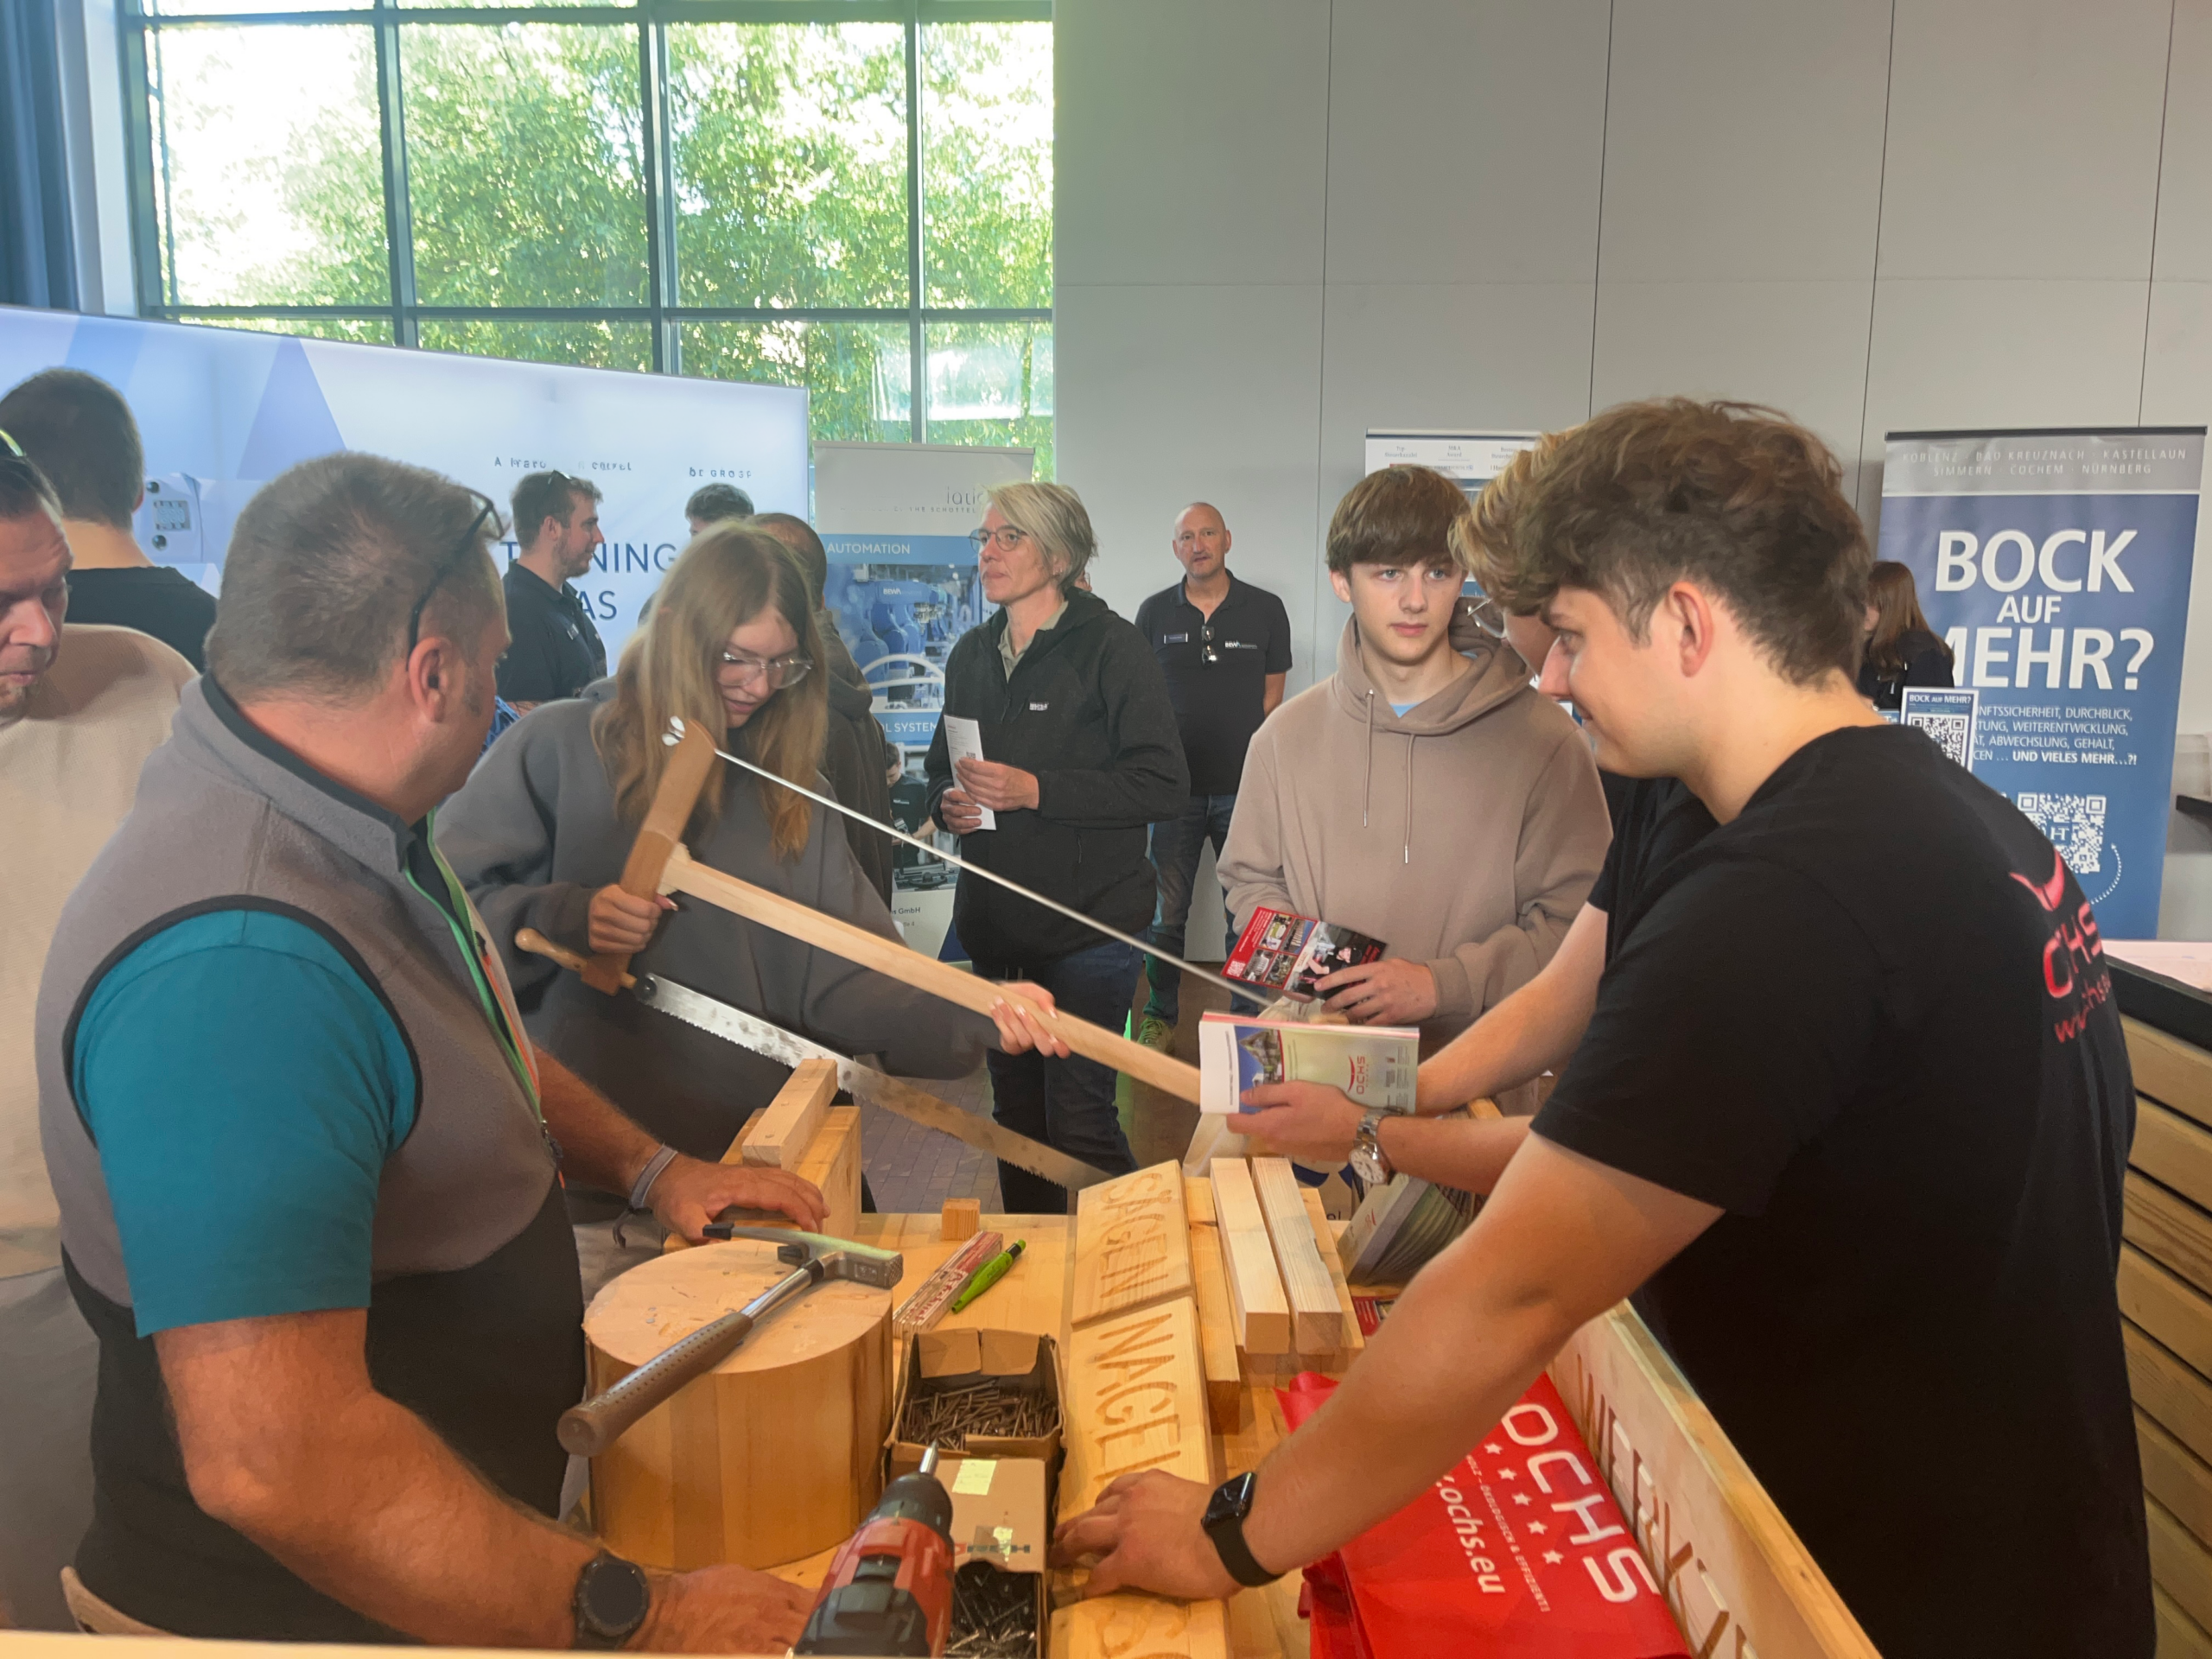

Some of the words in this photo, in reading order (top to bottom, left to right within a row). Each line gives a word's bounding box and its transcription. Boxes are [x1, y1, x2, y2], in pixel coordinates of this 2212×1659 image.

[2008, 449, 2085, 461] KREUZNACH
[2103, 448, 2186, 461] KASTELLAUN
[1934, 465, 1992, 477] SIMMERN
[2011, 464, 2063, 475] COCHEM
[827, 543, 910, 556] AUTOMATION
[1935, 528, 2139, 594] BOCK
[1996, 594, 2062, 624] AUF
[1944, 696, 1972, 704] MEHR?
[1979, 705, 2062, 720] NFTSSICHERHEIT,
[2065, 707, 2133, 721] DURCHBLICK,
[1977, 721, 2009, 733] TUNG,
[2012, 721, 2128, 736] WEITERENTWICKLUNG,
[1989, 735, 2070, 749] ABWECHSLUNG,
[2074, 737, 2115, 751] GEHALT,
[1973, 749, 1993, 761] CEN
[2012, 750, 2038, 762] UND
[2042, 751, 2078, 764] VIELES
[898, 906, 921, 915] GmbH
[1357, 1055, 1365, 1096] OCHS
[1100, 1172, 1173, 1299] SÄGEN
[1093, 1312, 1182, 1481] NAGEL
[1501, 1403, 1661, 1603] OCHS
